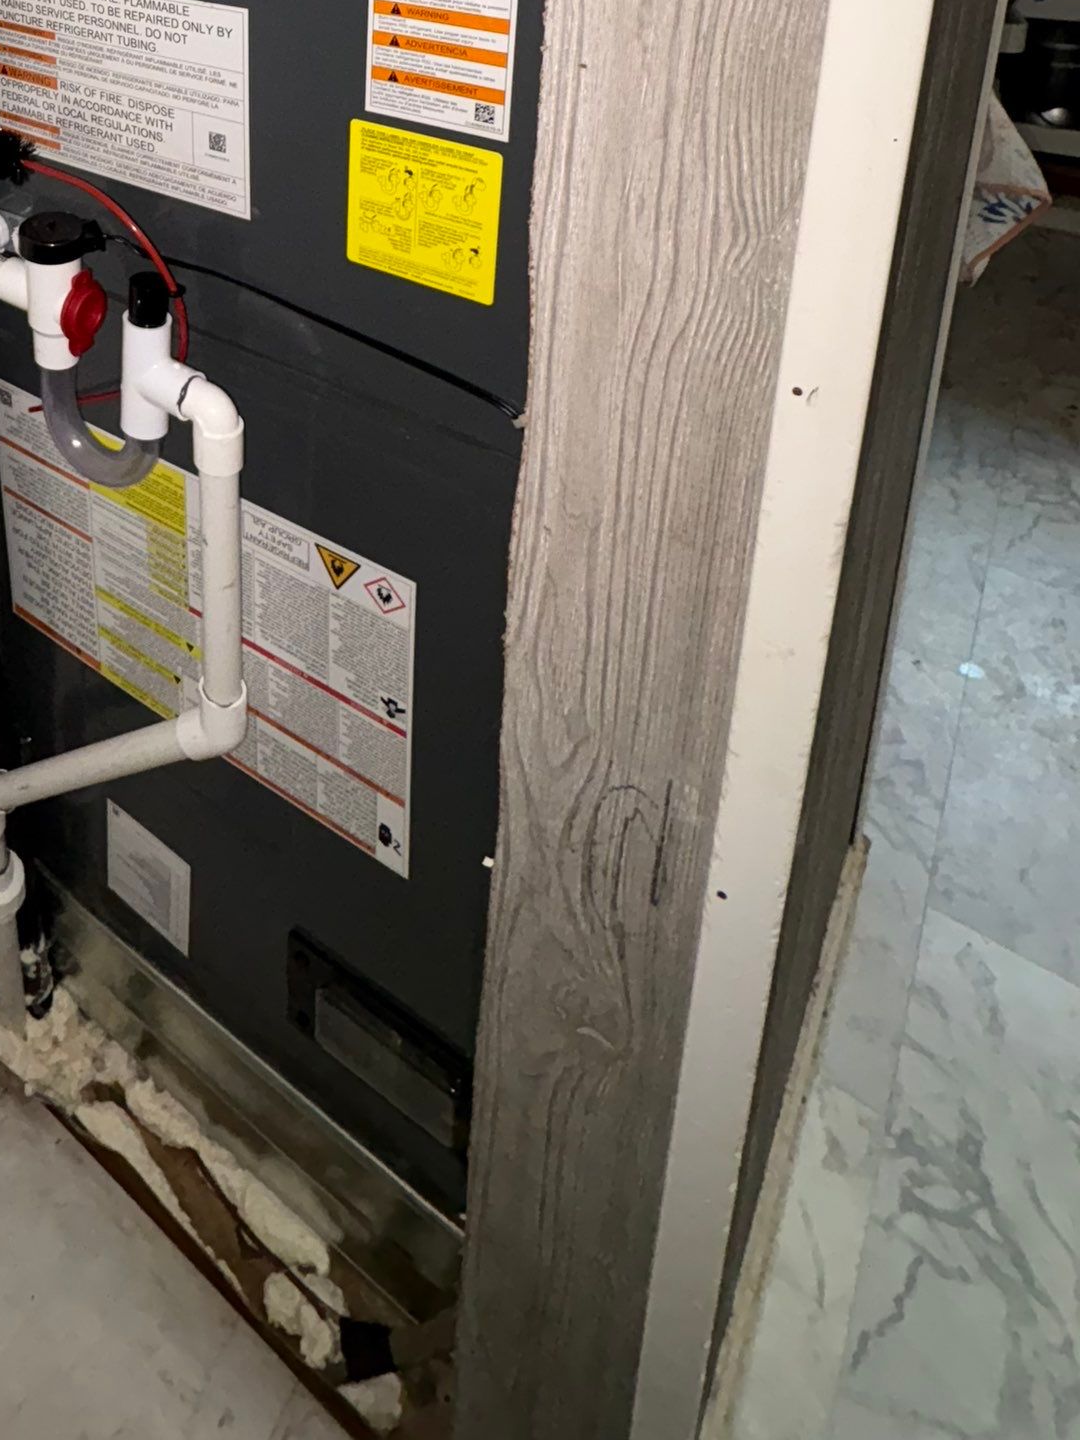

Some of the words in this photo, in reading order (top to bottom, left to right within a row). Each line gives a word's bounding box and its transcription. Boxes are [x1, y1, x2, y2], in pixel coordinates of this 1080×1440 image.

[34, 3, 76, 23] SERVICE
[76, 12, 140, 36] PERSONNEL.
[143, 25, 163, 41] DO
[162, 29, 188, 46] NOT
[90, 1, 106, 15] TO
[105, 4, 121, 19] BE
[122, 7, 180, 30] REPAIRED
[180, 18, 214, 37] ONLY
[215, 25, 233, 41] BY
[405, 6, 450, 21] WARNING
[44, 18, 114, 44] REFRIGERANT
[116, 33, 158, 54] TUBING.
[404, 39, 468, 58] ADVERTENCIA
[7, 66, 51, 88] WARNING
[58, 79, 82, 95] RISK
[82, 84, 97, 99] OF
[126, 96, 175, 120] DISPOSE
[402, 73, 479, 97] AVERTISSEMENT
[0, 87, 40, 109] FEDERAL
[40, 98, 57, 114] OR
[56, 103, 88, 123] LOCAL
[59, 91, 72, 105] IN
[71, 95, 143, 125] ACCORDANCE
[143, 114, 174, 133] WITH
[0, 99, 54, 126] FLAMMABLE
[54, 115, 123, 146] REFRIGERANT
[124, 134, 157, 156] USED.
[242, 531, 308, 571] REFRIGERANT
[258, 531, 293, 552] SAFETY
[267, 526, 303, 546] GROUP
